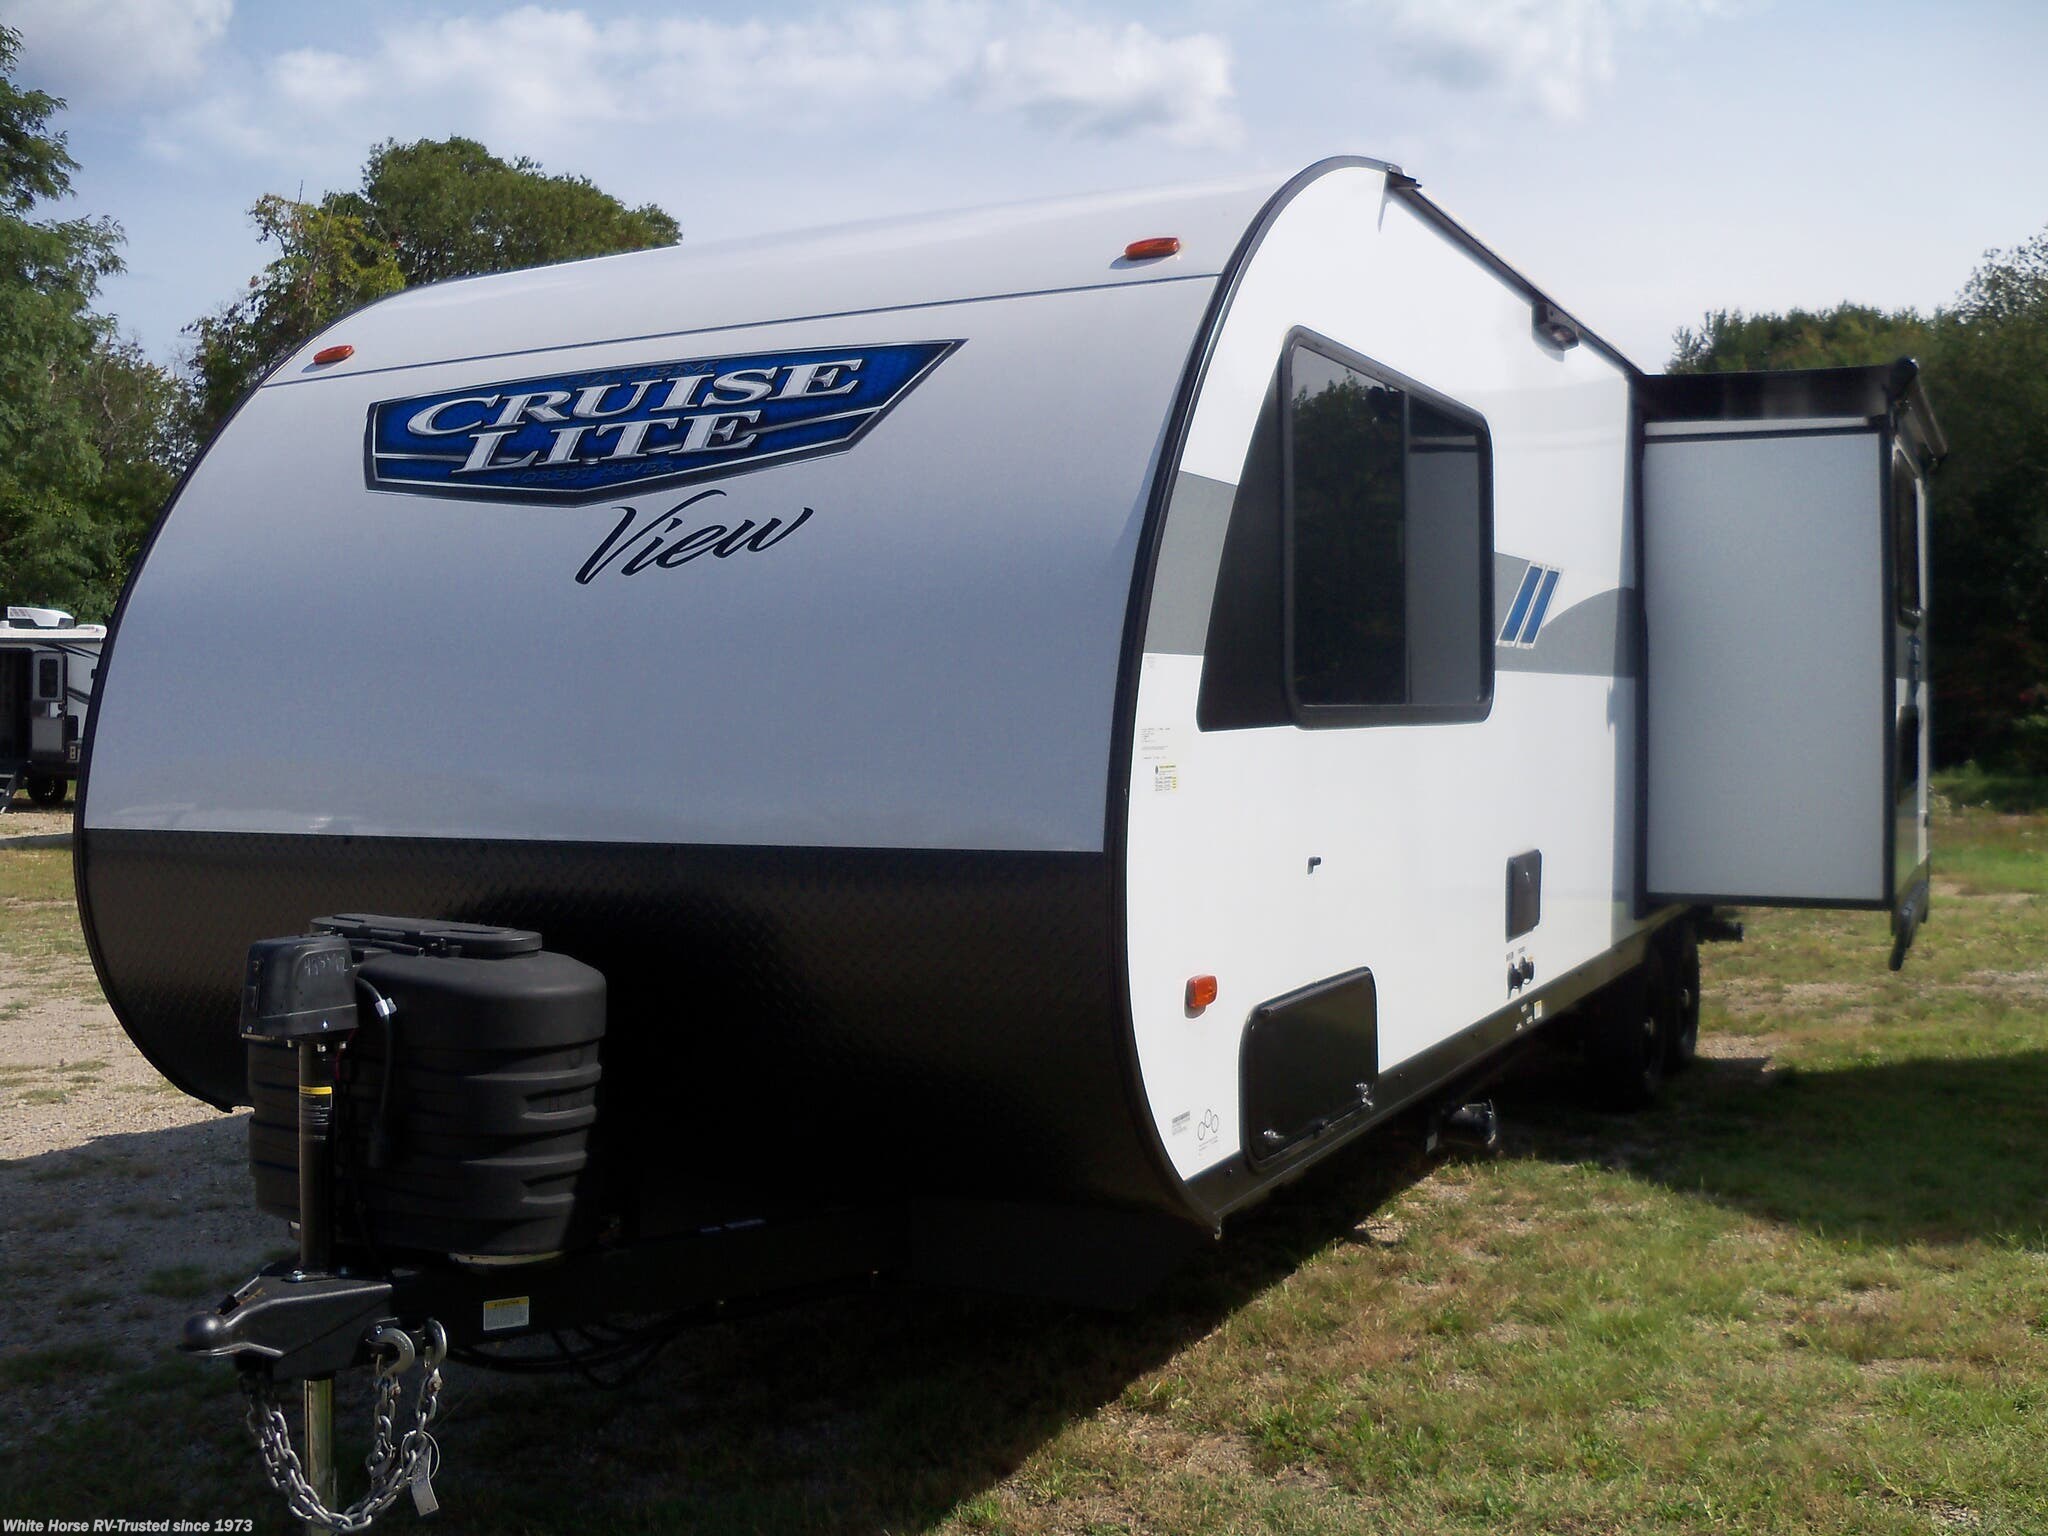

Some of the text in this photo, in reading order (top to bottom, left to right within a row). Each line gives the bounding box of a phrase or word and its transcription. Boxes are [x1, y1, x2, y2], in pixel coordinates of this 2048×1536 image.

[407, 358, 863, 436] CRUISE
[451, 410, 761, 474] LITE
[574, 489, 815, 585] View
